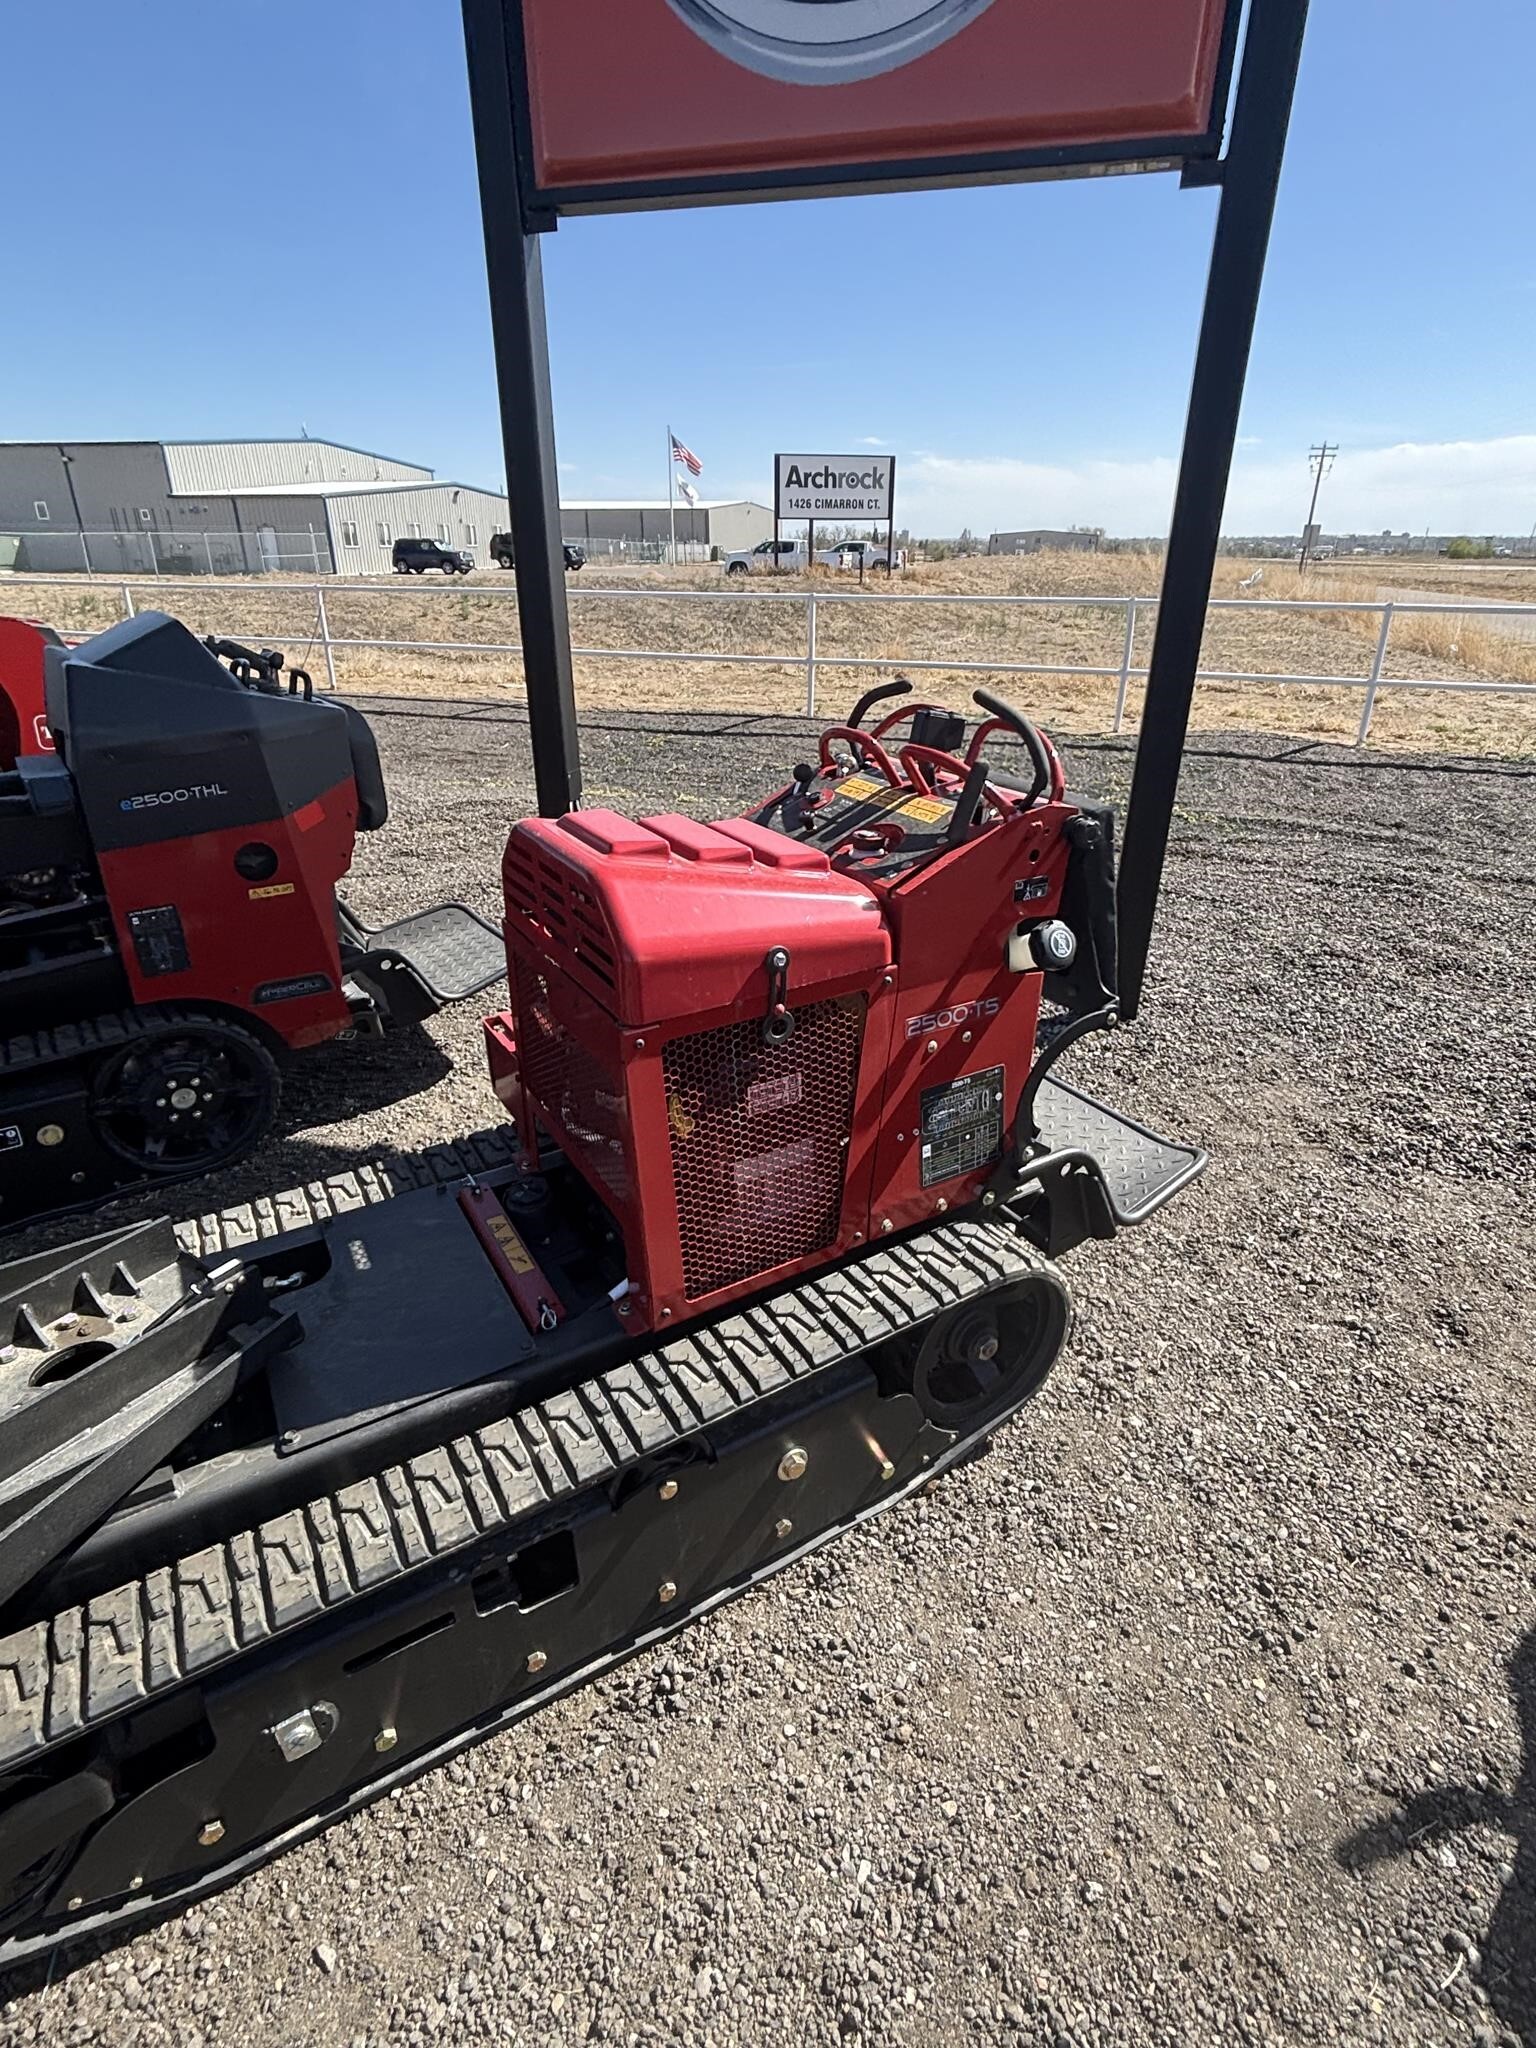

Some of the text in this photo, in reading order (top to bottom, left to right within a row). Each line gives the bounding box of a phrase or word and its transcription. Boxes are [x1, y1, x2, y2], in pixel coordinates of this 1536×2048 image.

[785, 465, 884, 489] Archrock
[789, 499, 880, 510] 1426 CIMARRON CT.
